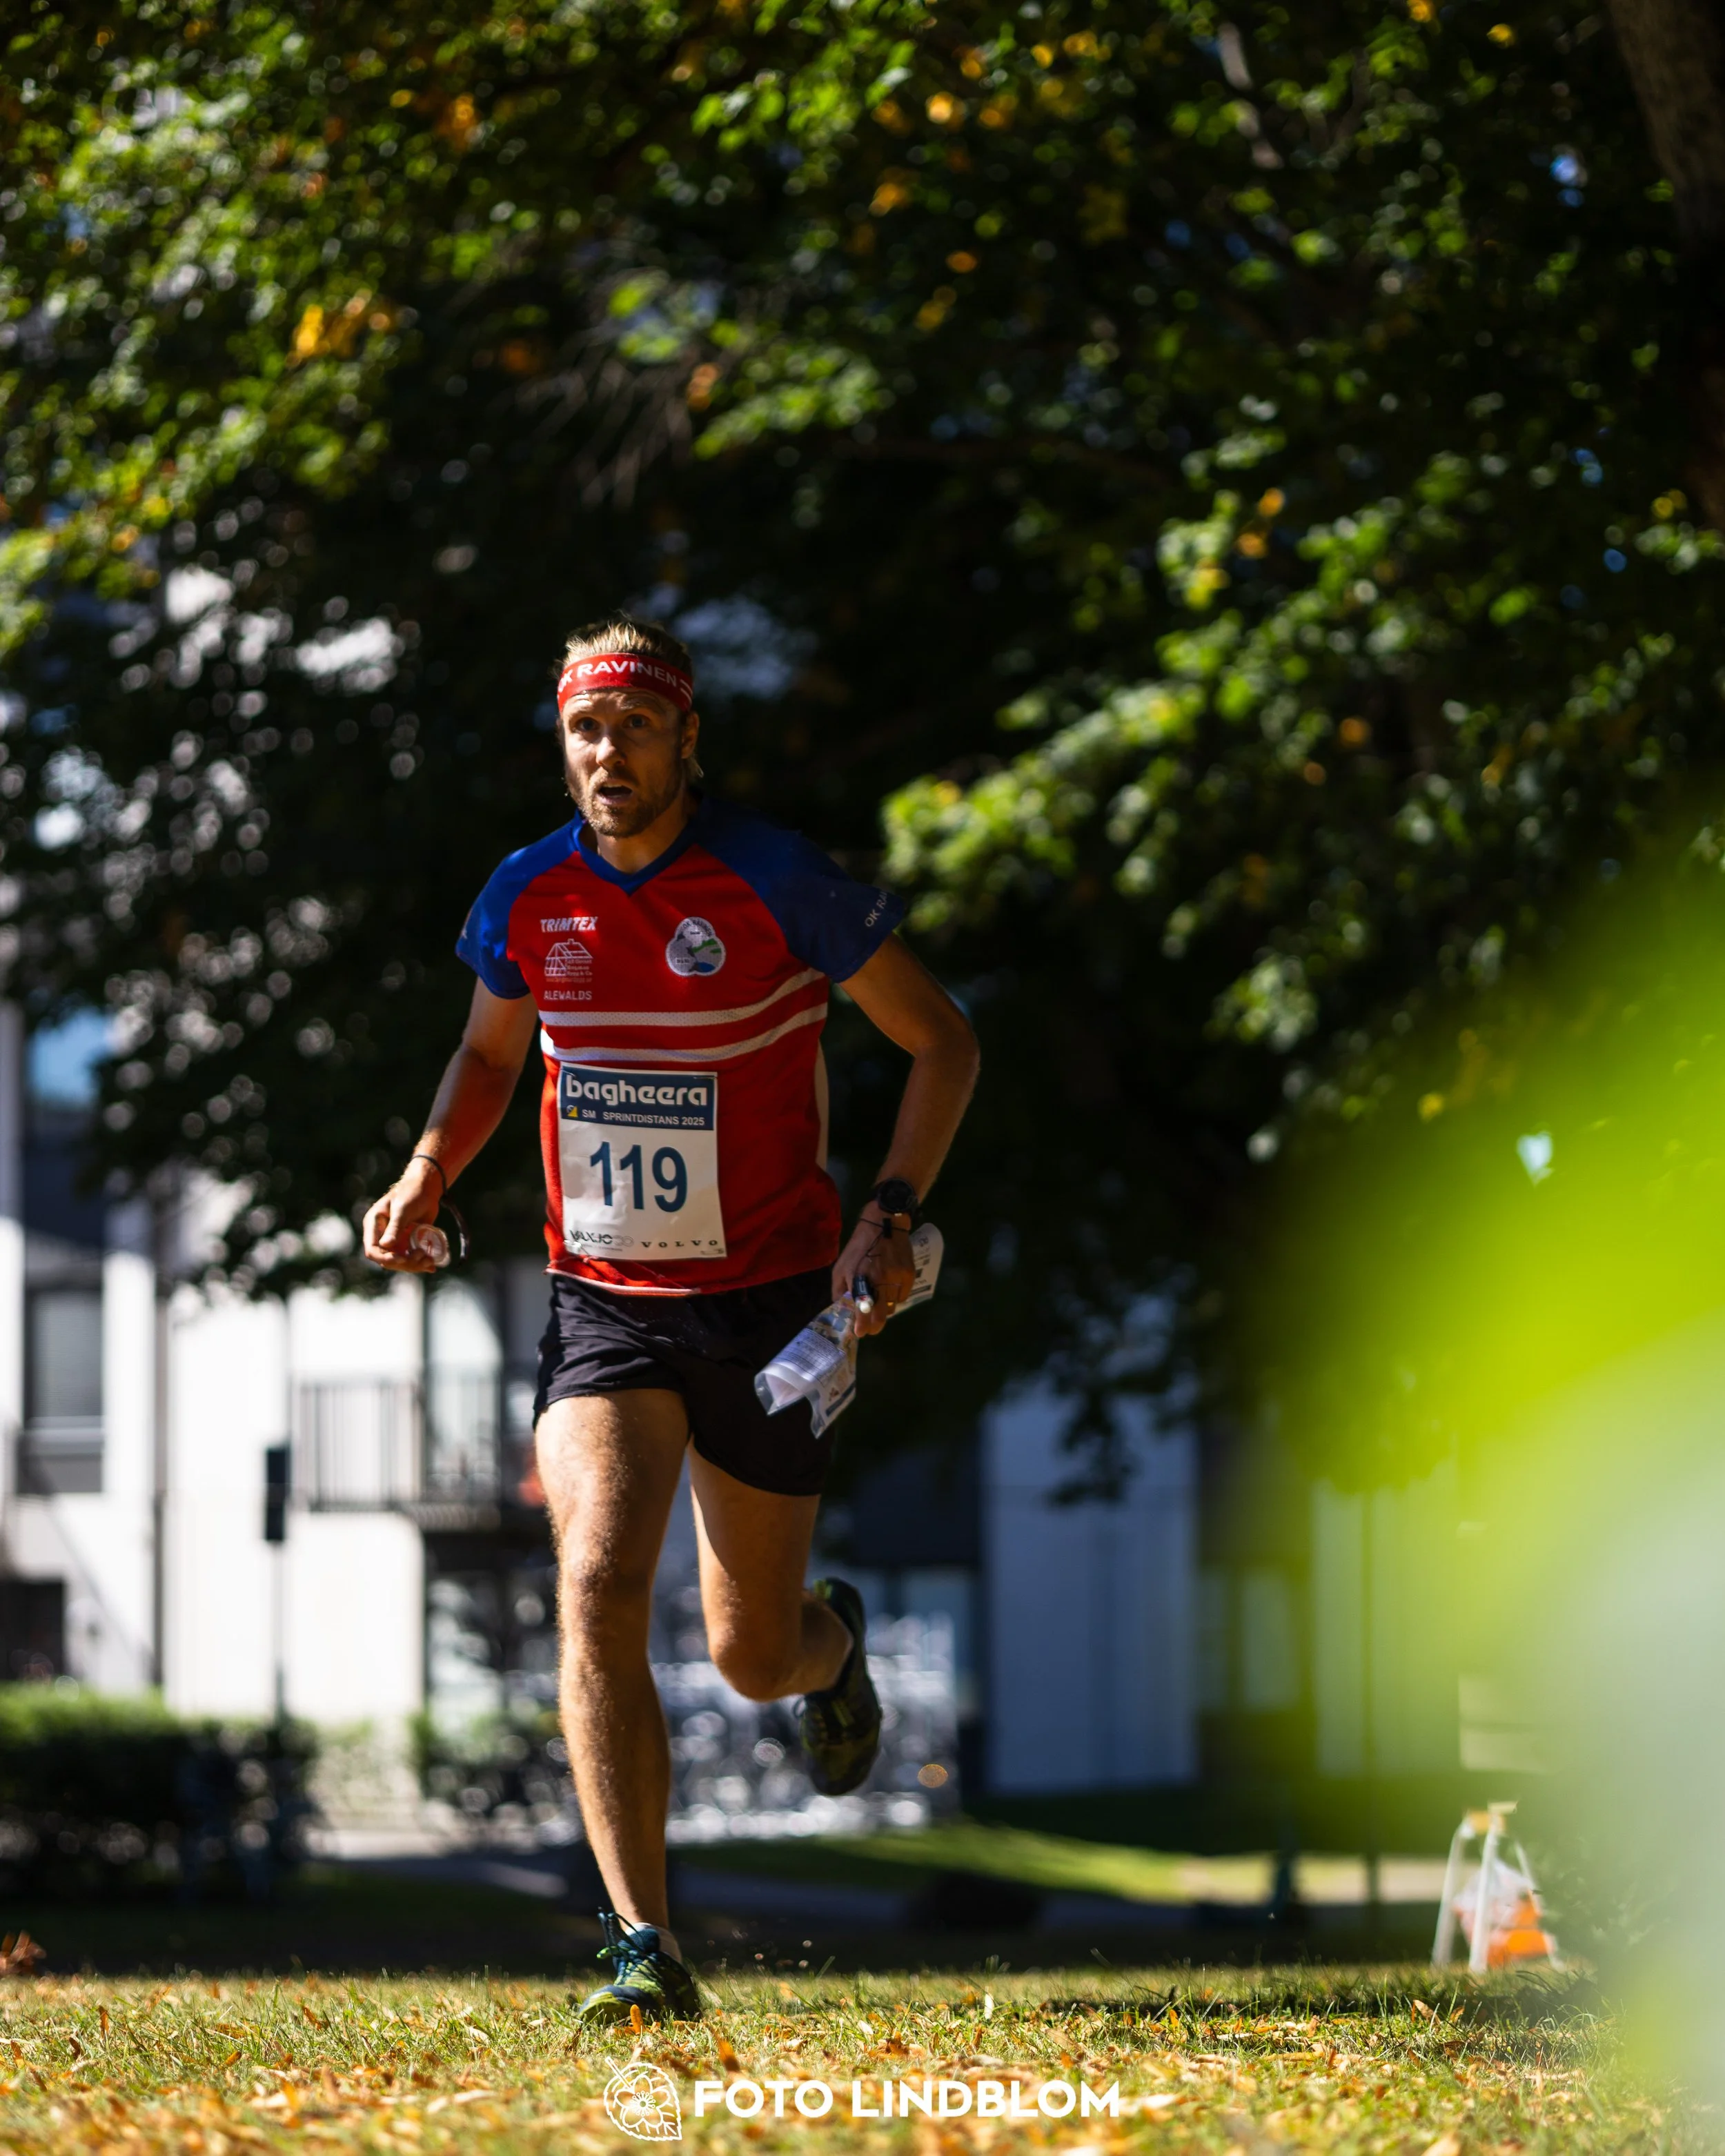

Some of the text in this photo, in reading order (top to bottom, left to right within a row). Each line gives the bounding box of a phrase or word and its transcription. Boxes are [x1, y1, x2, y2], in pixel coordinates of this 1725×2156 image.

[576, 660, 678, 687] RAVINEN
[540, 916, 599, 933] TRIMTEX
[865, 909, 882, 927] OK
[544, 990, 593, 1000] ALEWALDS
[566, 1074, 707, 1106] bagheera
[582, 1109, 705, 1126] SM SPRINTDISTANS 2025
[590, 1140, 688, 1213] 119
[641, 1239, 718, 1248] VOLVO
